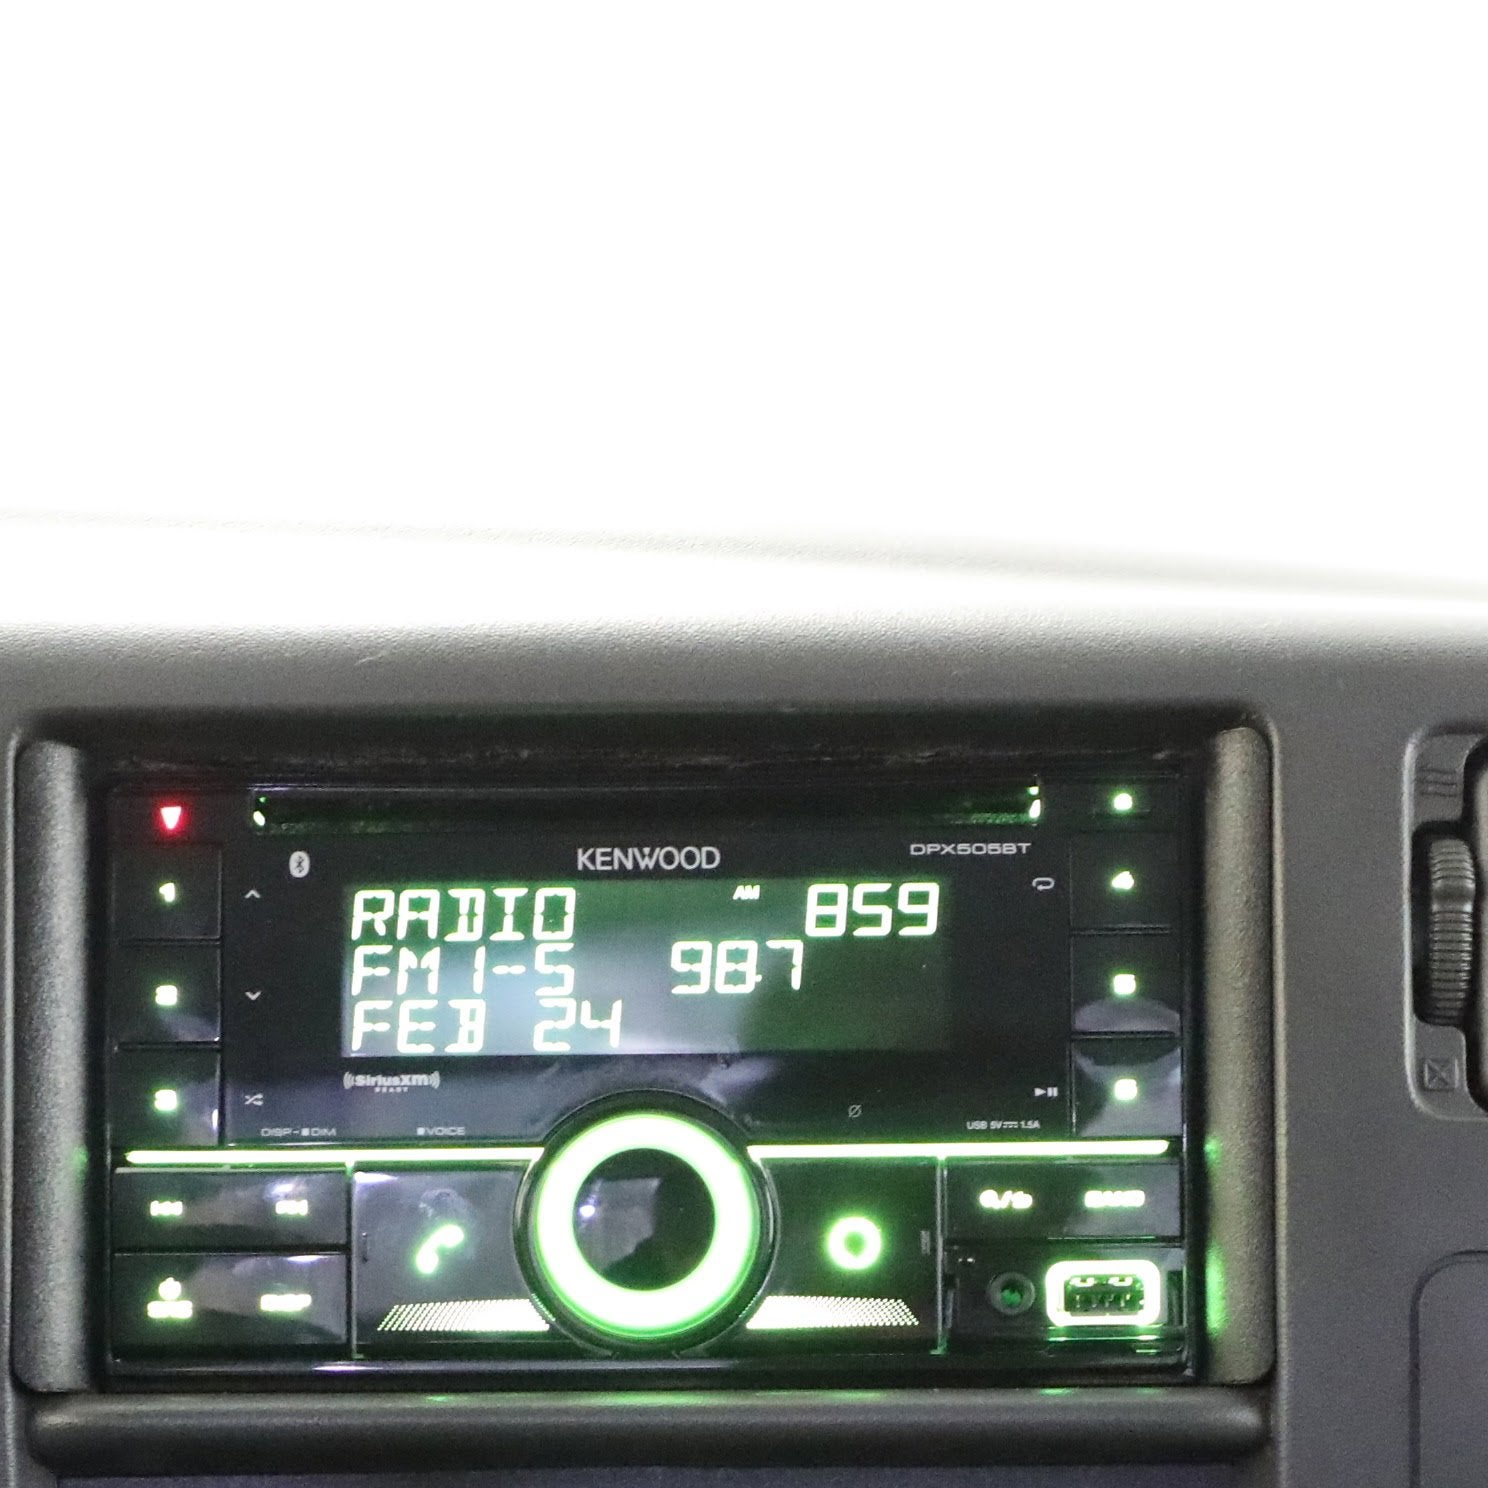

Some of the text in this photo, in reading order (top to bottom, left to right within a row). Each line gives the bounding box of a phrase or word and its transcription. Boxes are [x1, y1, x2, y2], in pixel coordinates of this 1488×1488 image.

[577, 846, 721, 870] KENWOOD
[910, 843, 1031, 855] DPX505BT
[733, 885, 760, 900] AM
[351, 887, 576, 941] RADIO
[805, 882, 940, 937] 859
[351, 996, 622, 1053] FEB 24
[425, 1127, 465, 1135] VOICE
[966, 1120, 988, 1129] USB
